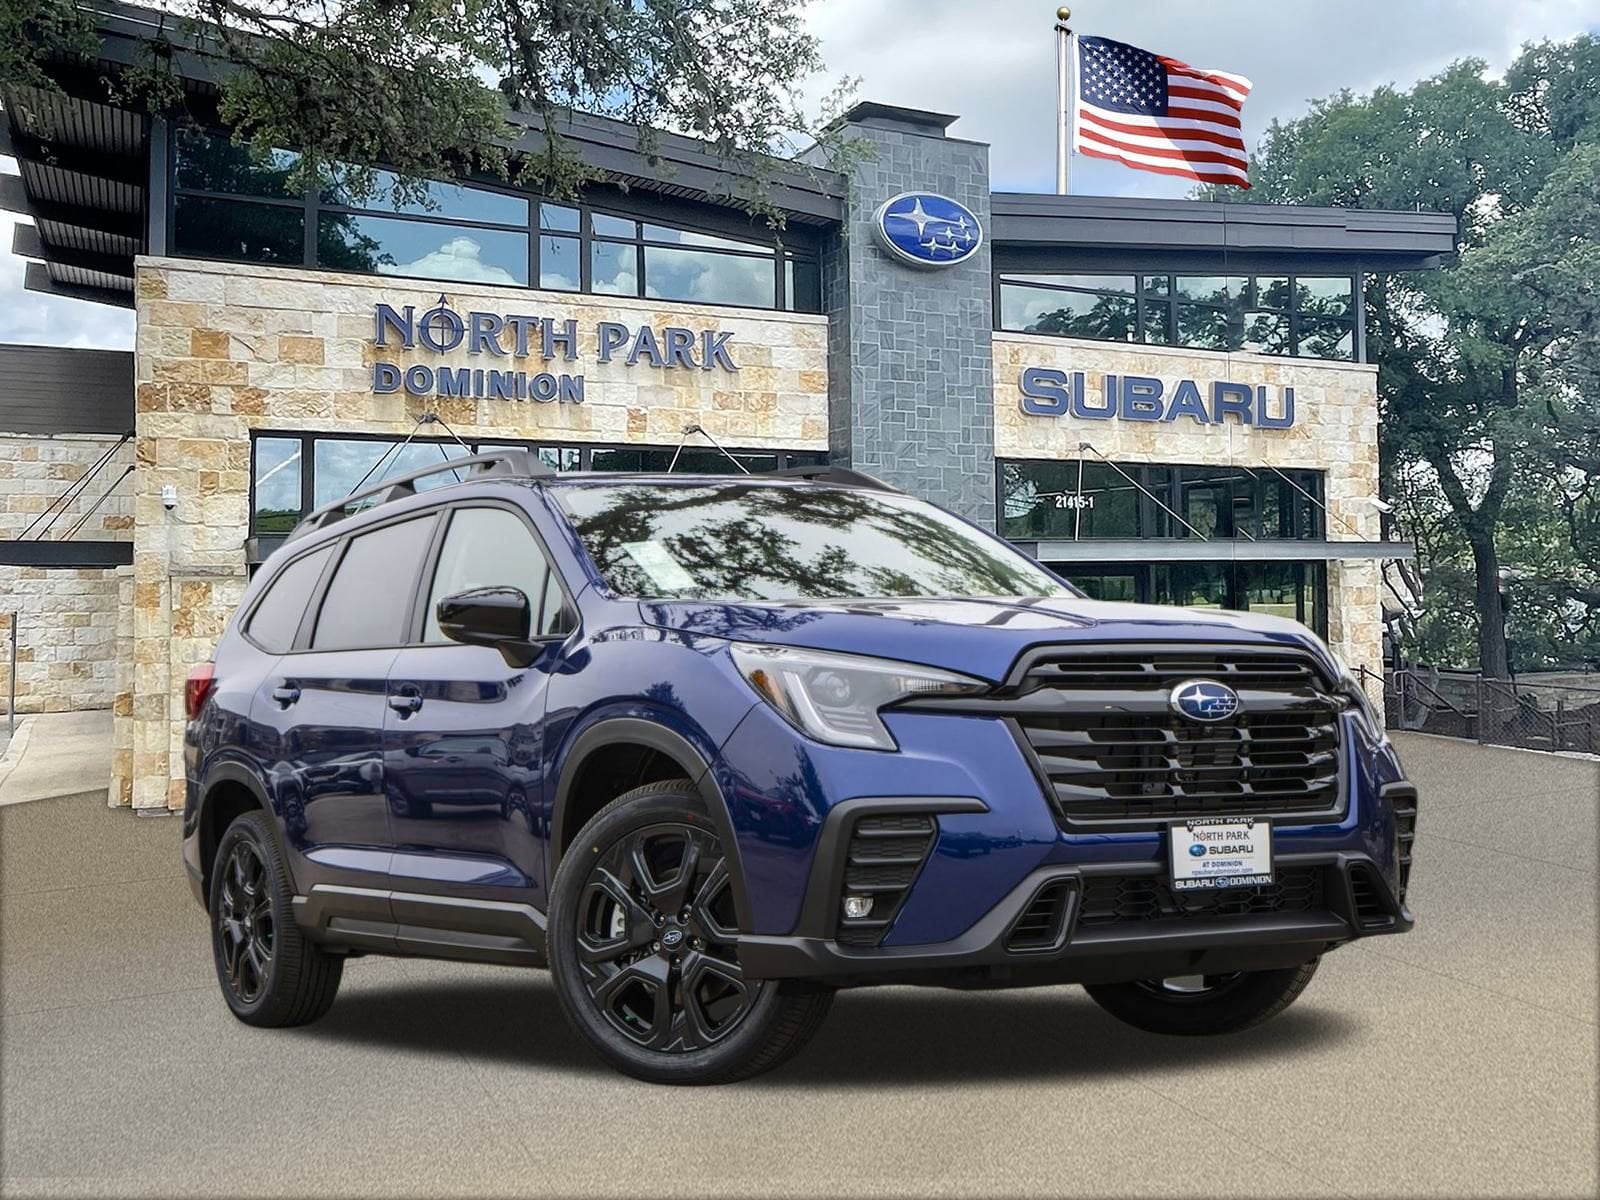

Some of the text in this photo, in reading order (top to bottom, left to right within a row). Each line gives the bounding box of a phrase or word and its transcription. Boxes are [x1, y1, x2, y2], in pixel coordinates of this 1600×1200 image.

[375, 294, 742, 373] NORTH PARK
[373, 362, 585, 404] DOMINION
[1019, 367, 1295, 430] SUBARU
[1186, 816, 1254, 826] NORTH PARK
[1193, 830, 1250, 841] NORTH PARK
[1209, 845, 1254, 855] SUBARU
[1211, 860, 1243, 868] DOMINION
[1175, 875, 1272, 889] SUBARU DOMINION
